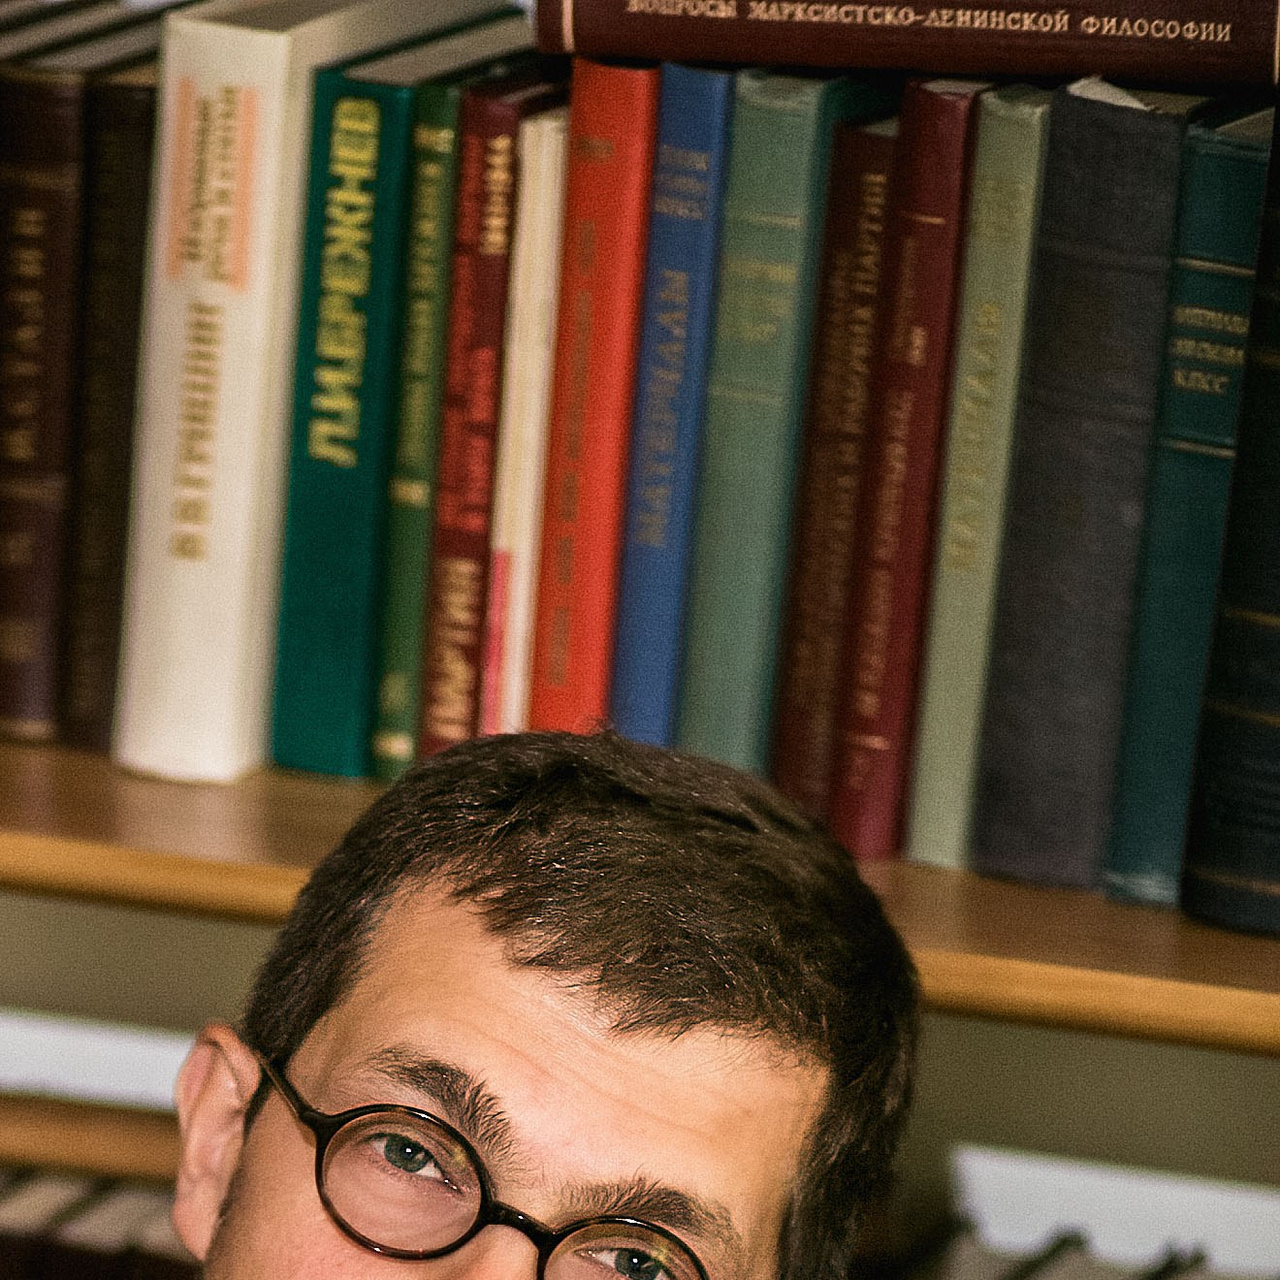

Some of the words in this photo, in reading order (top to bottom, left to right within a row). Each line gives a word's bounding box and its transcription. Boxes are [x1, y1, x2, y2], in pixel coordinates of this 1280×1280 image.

[746, 1, 1070, 32] МАРКСИСТСКО-ЛЕНИНСКОЙ
[1079, 15, 1232, 42] ФИЛОСОФИИ
[634, 269, 691, 548] МАТЕРИАЛЫ
